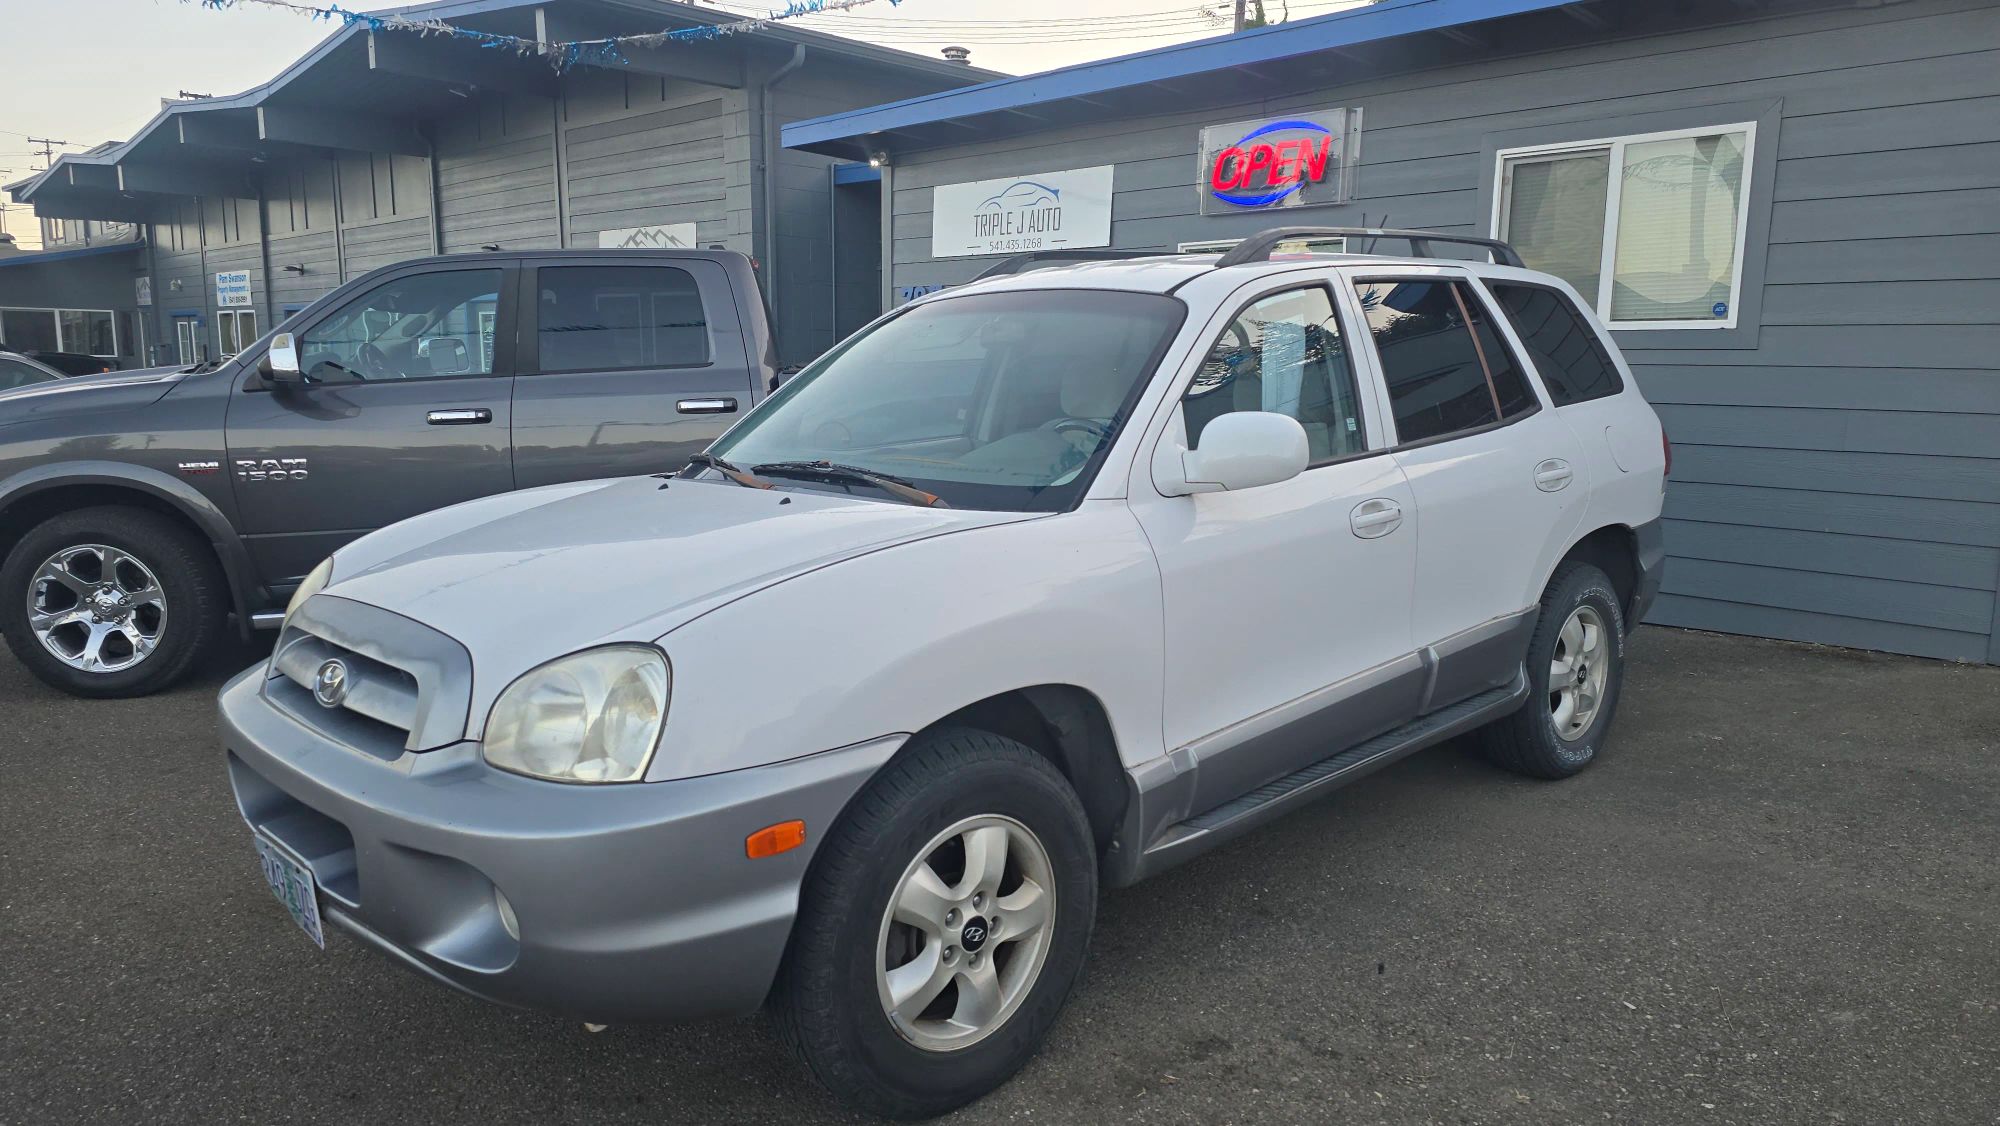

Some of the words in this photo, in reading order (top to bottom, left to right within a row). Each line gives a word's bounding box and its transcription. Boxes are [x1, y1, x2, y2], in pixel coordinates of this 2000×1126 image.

[1210, 134, 1332, 192] OPEN
[973, 211, 1013, 238] TRIPLE
[1016, 210, 1024, 234] J
[1028, 206, 1062, 234] AUTO
[989, 237, 1042, 252] 541.435.1268
[178, 461, 219, 469] HEMI
[235, 458, 308, 470] RAM
[237, 469, 309, 481] 1500
